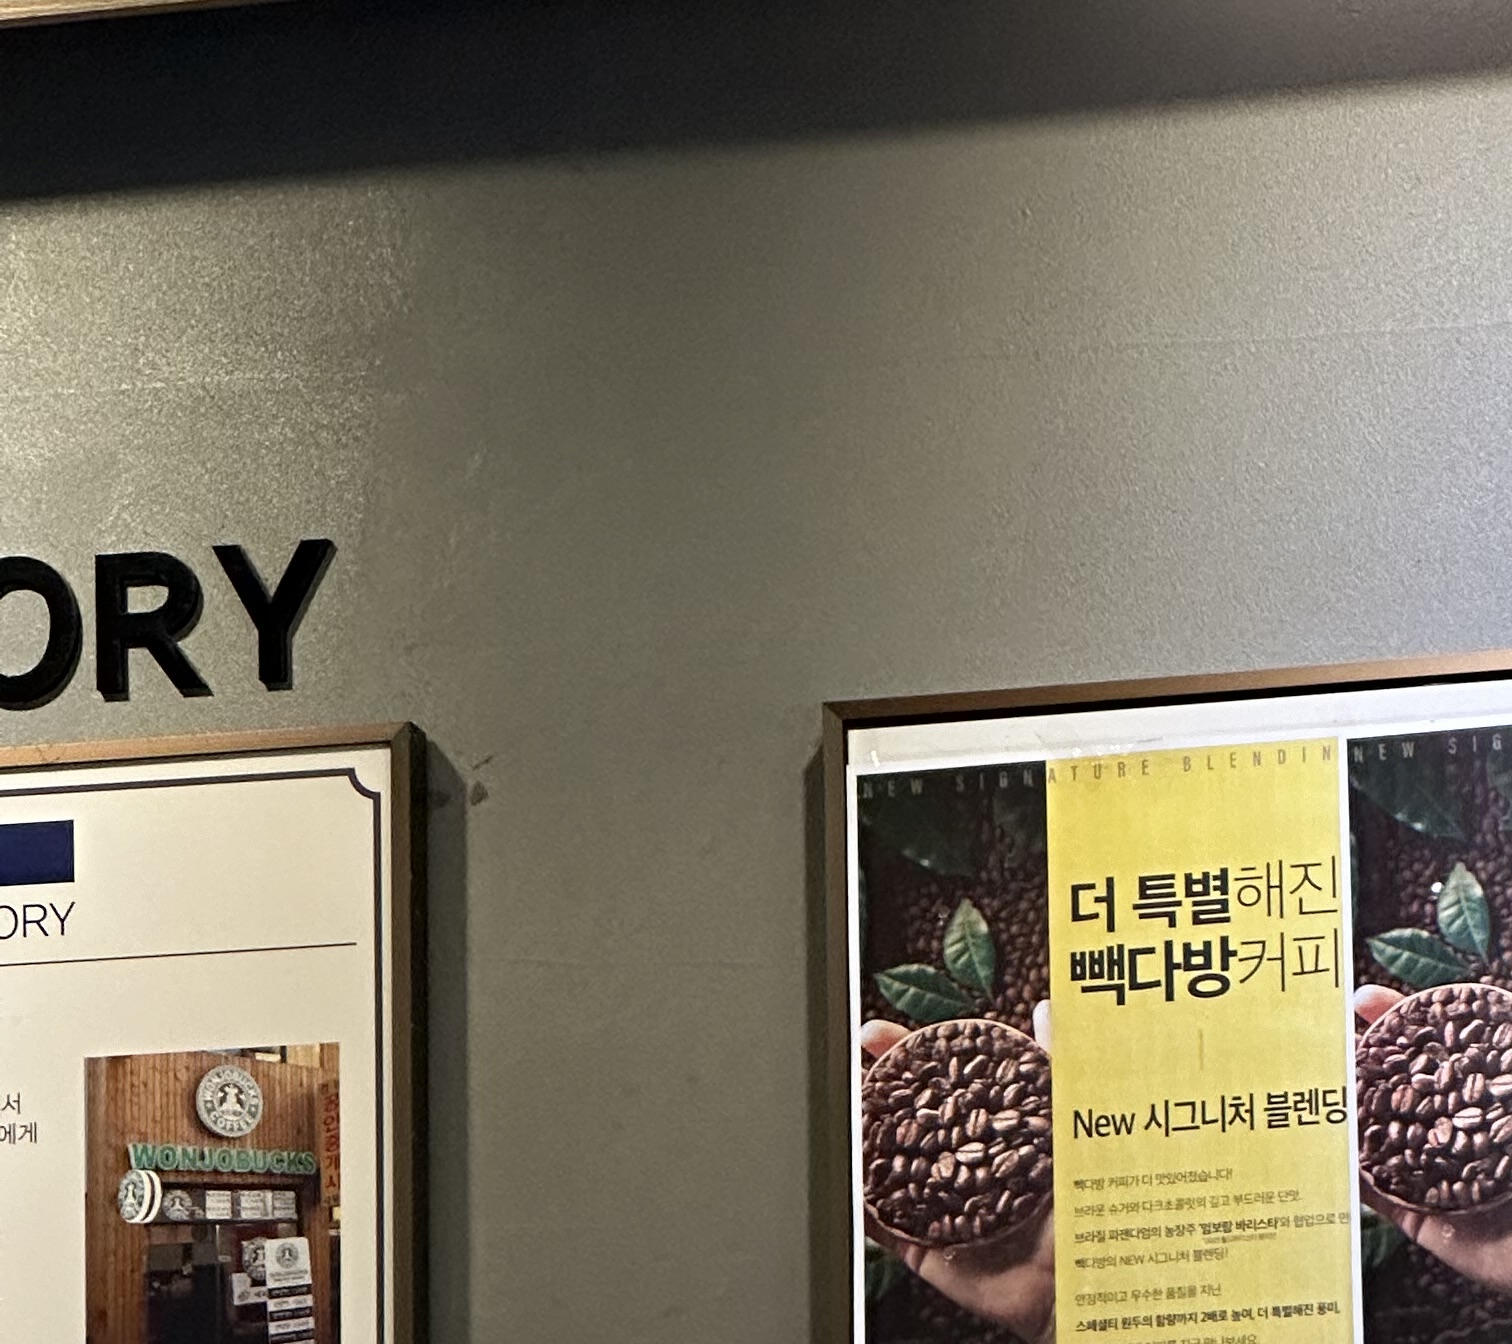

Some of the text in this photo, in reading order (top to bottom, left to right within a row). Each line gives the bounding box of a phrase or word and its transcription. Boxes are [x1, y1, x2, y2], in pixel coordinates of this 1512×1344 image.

[1354, 742, 1415, 764] NEW
[1069, 855, 1340, 933] 더 특별해진
[1069, 928, 1342, 1006] 빽다방커피
[1073, 1086, 1348, 1139] New 시그니처 블렌딩
[129, 1143, 318, 1175] WONJOBUCKS
